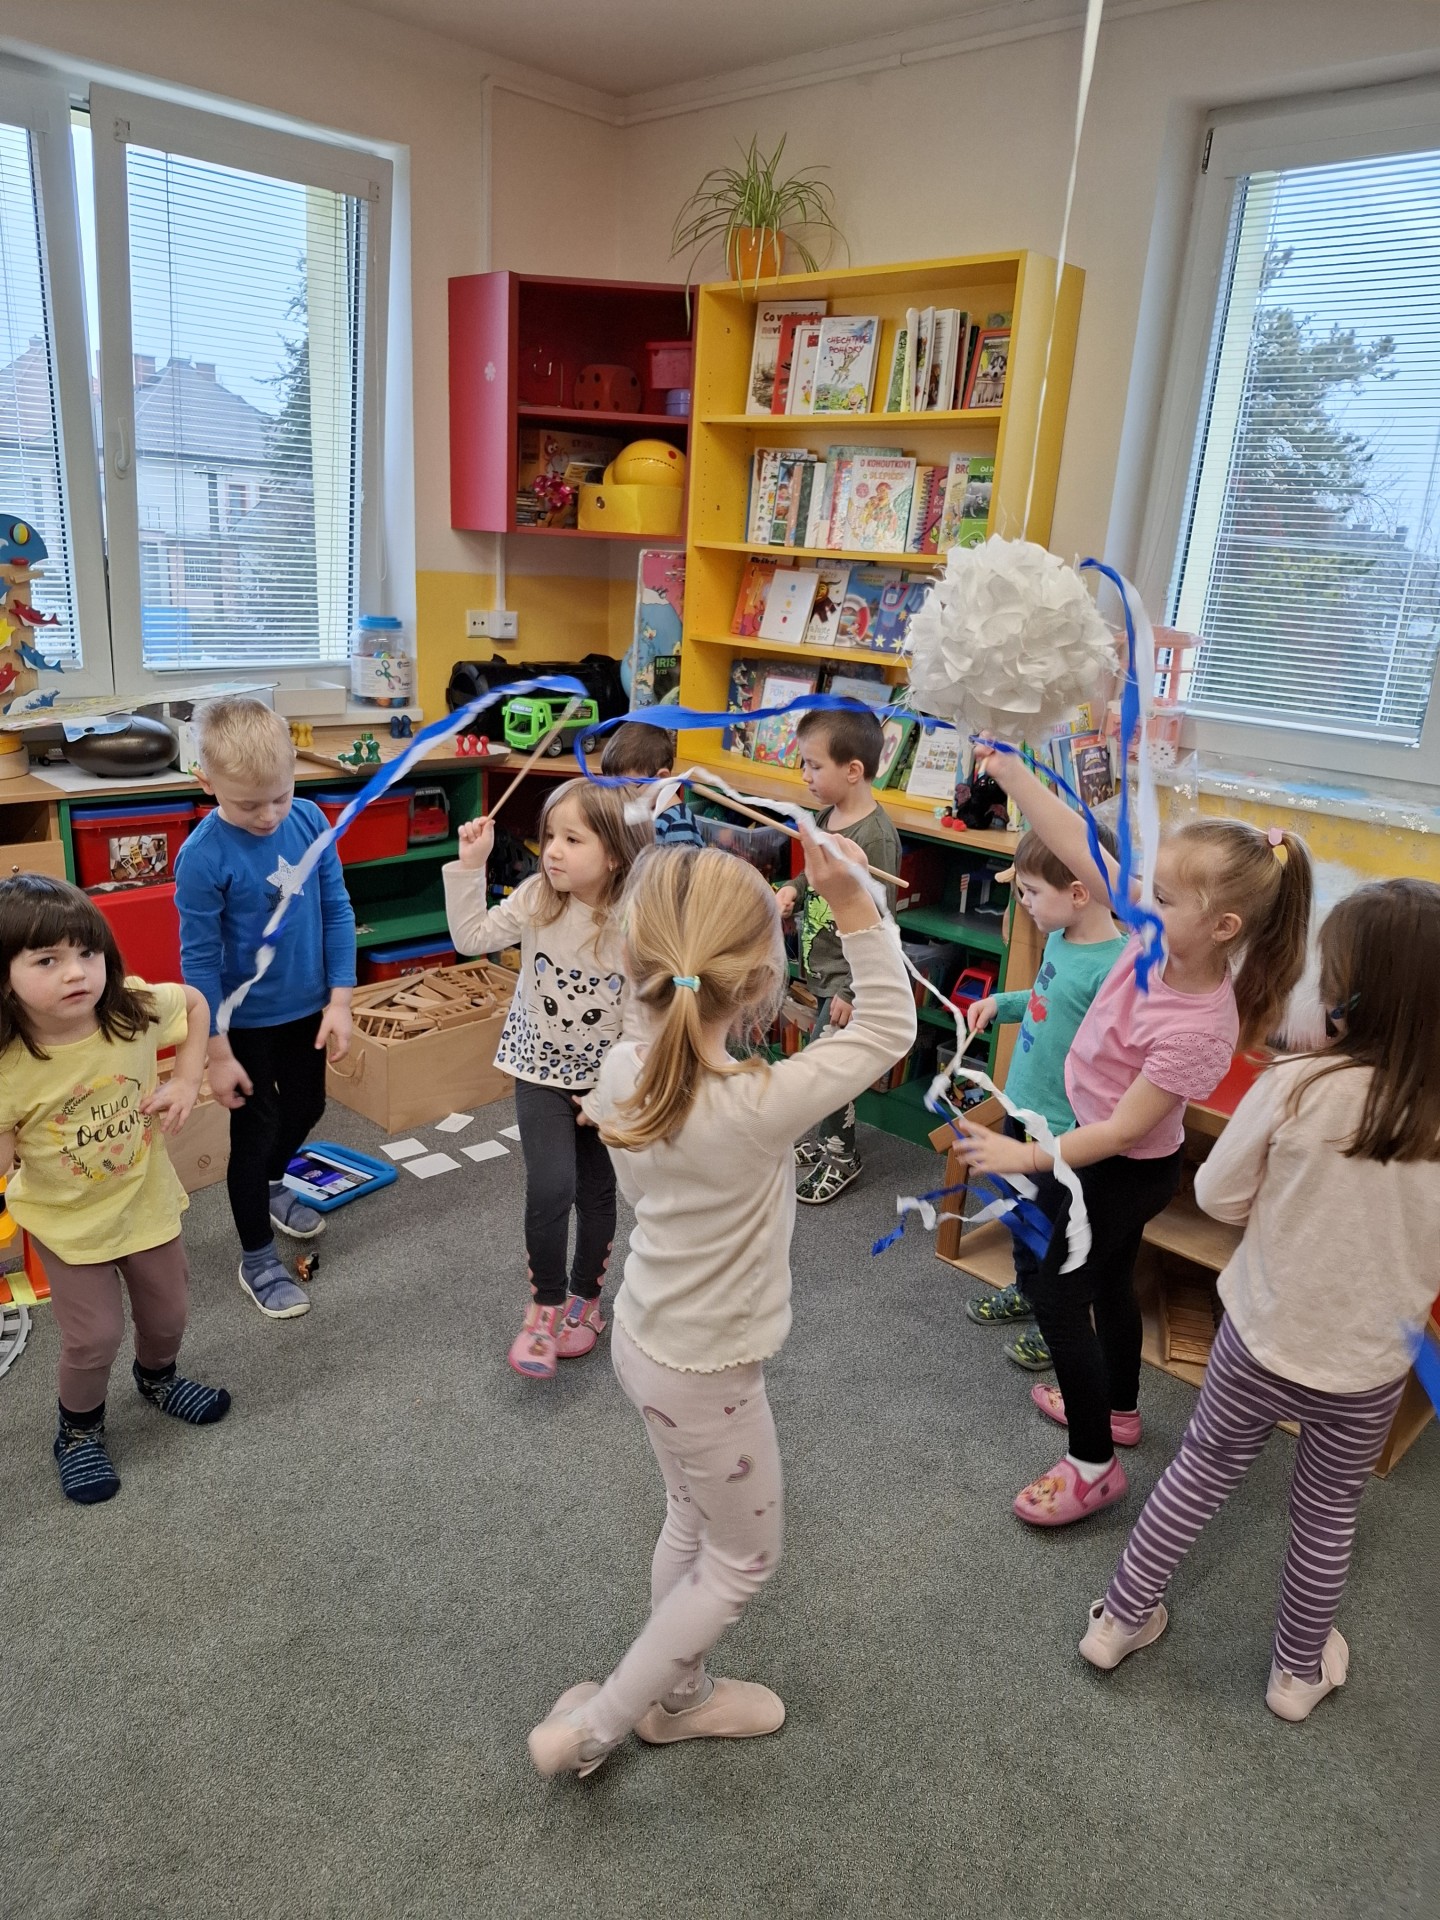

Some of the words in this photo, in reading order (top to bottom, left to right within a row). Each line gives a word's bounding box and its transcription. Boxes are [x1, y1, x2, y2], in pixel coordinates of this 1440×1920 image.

[763, 312, 775, 322] Co
[867, 459, 911, 468] KOHOUTKOVI
[656, 657, 676, 668] IRIS
[90, 1095, 128, 1121] HELLO
[76, 1109, 141, 1147] Ocean
